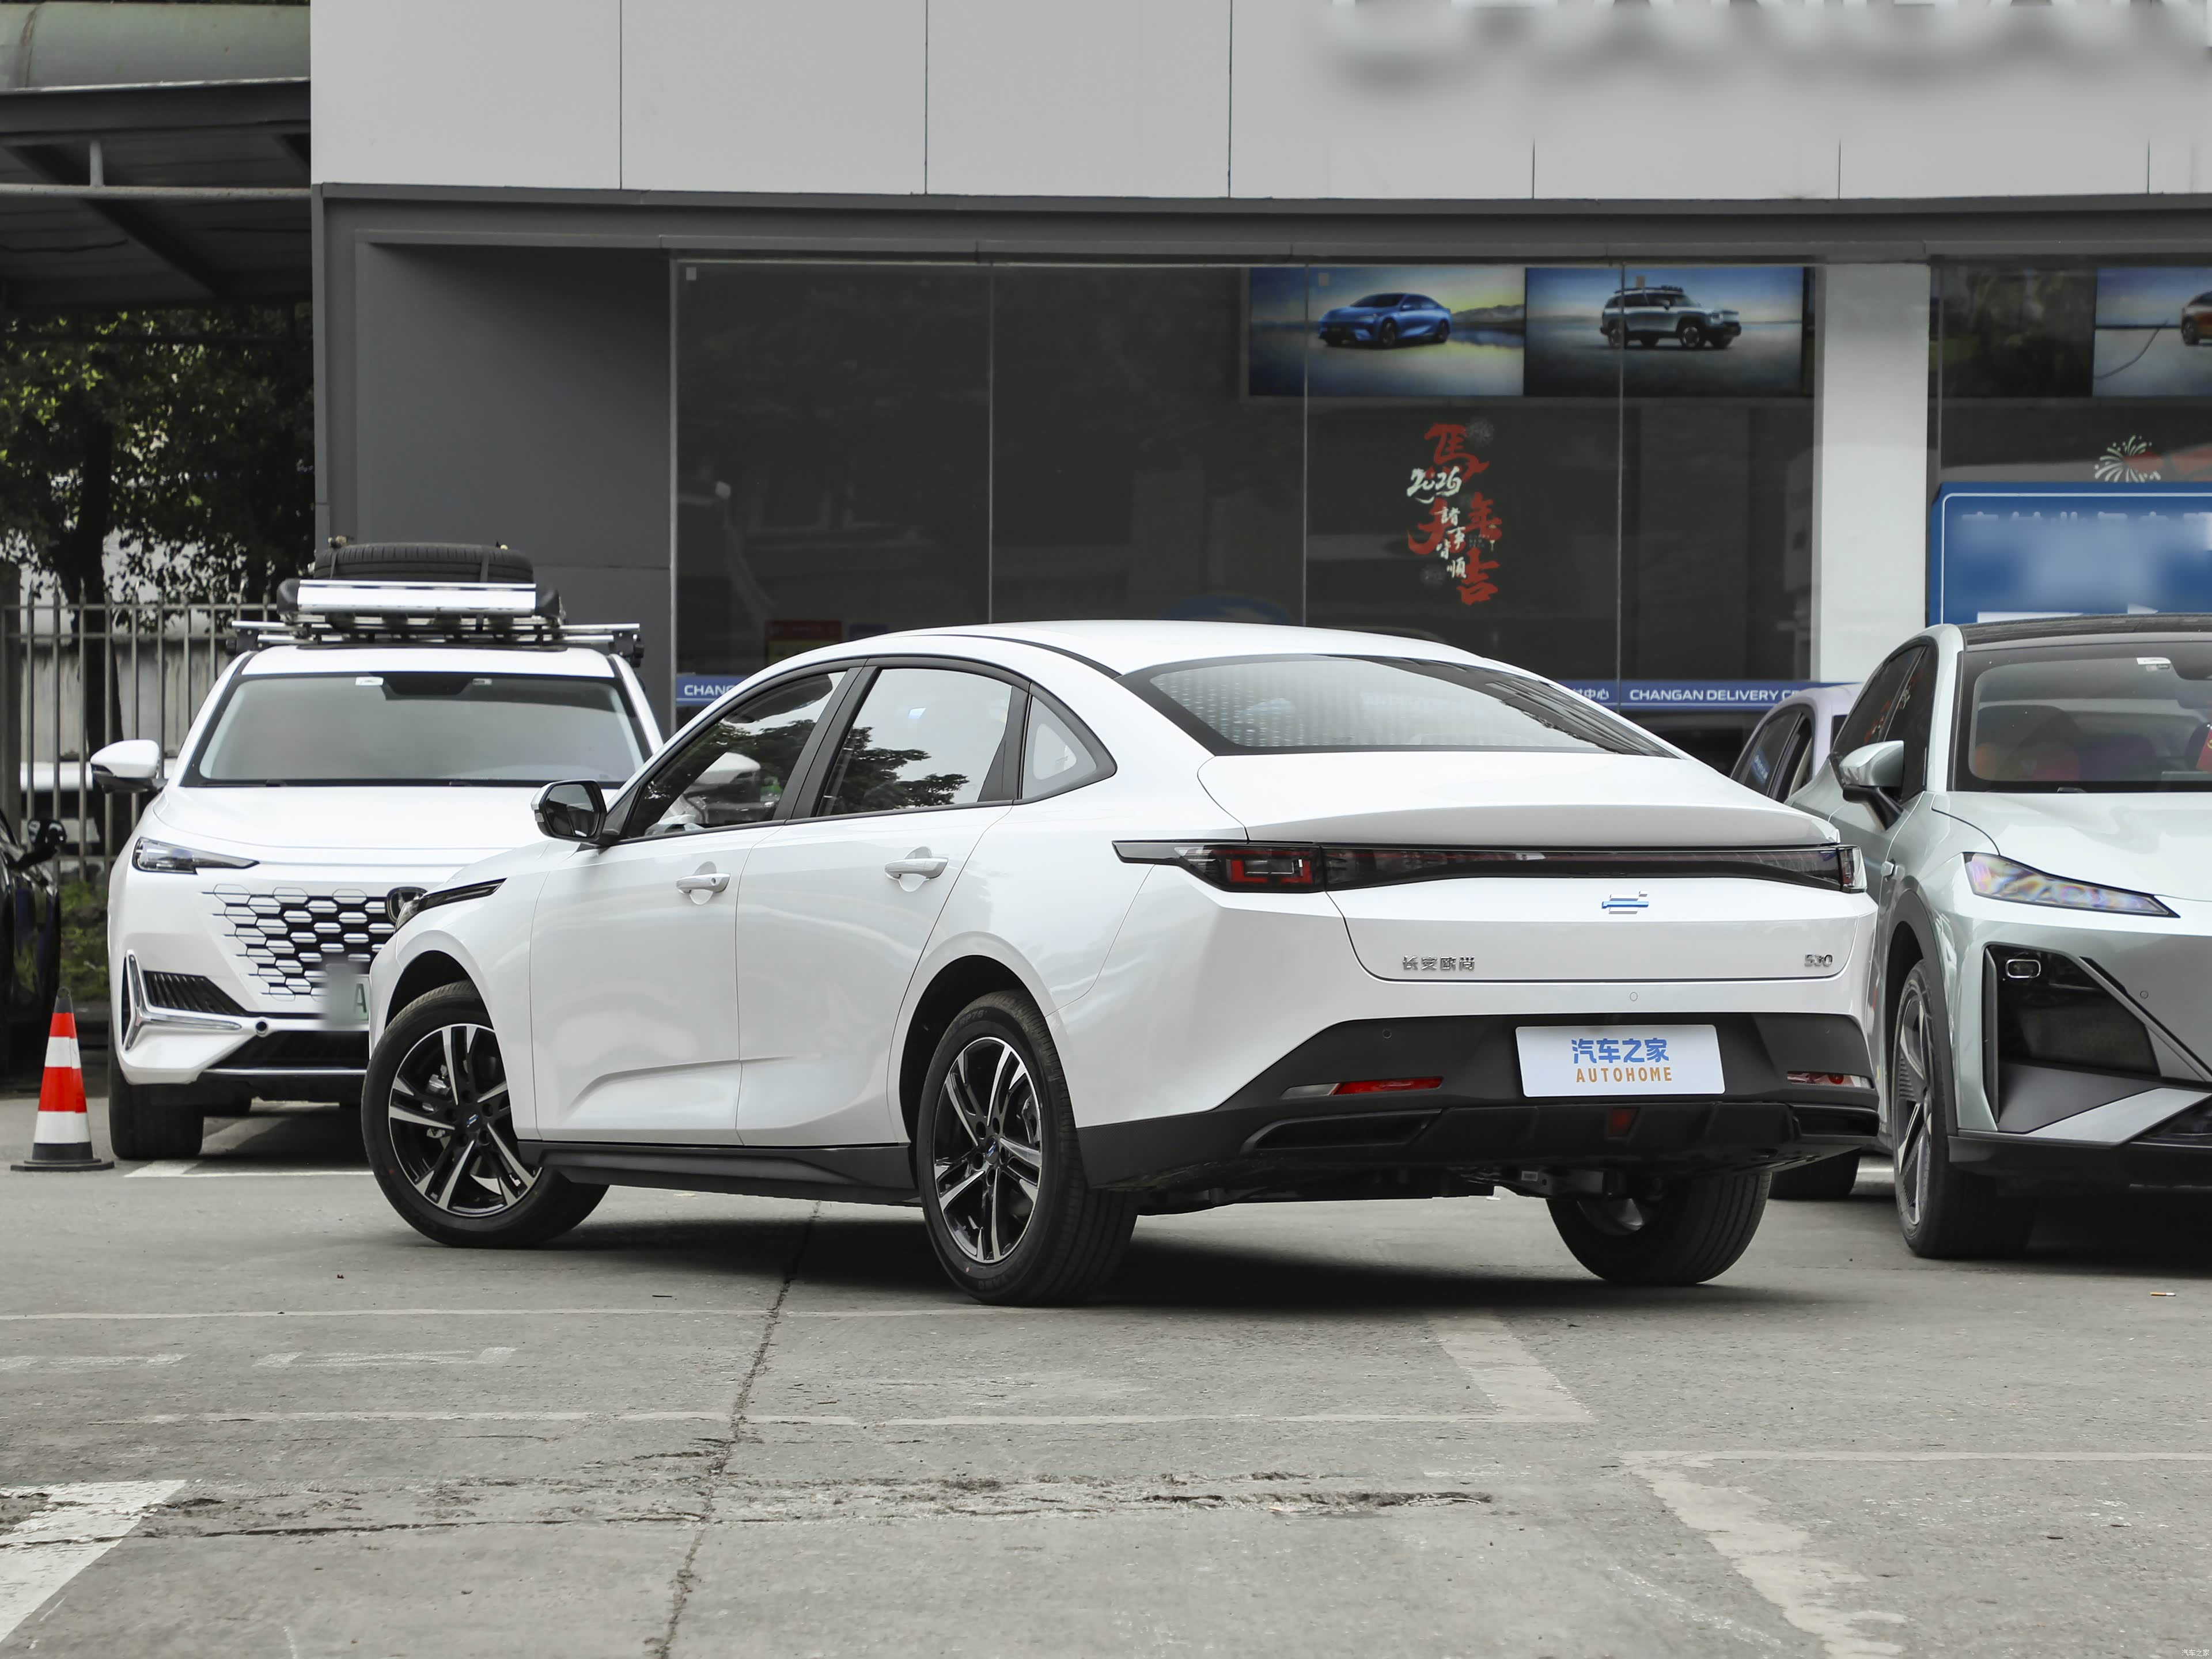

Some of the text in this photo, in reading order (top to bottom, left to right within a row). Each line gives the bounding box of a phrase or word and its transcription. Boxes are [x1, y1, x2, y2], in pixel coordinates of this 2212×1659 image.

[1407, 465, 1463, 505] 2026
[1630, 690, 1703, 700] CHANGAN
[1707, 690, 1779, 700] DELIVERY
[1402, 955, 1475, 971] 长安欧尚
[1571, 1038, 1669, 1063] 汽车之家
[1576, 1067, 1672, 1082] AUTOHOME
